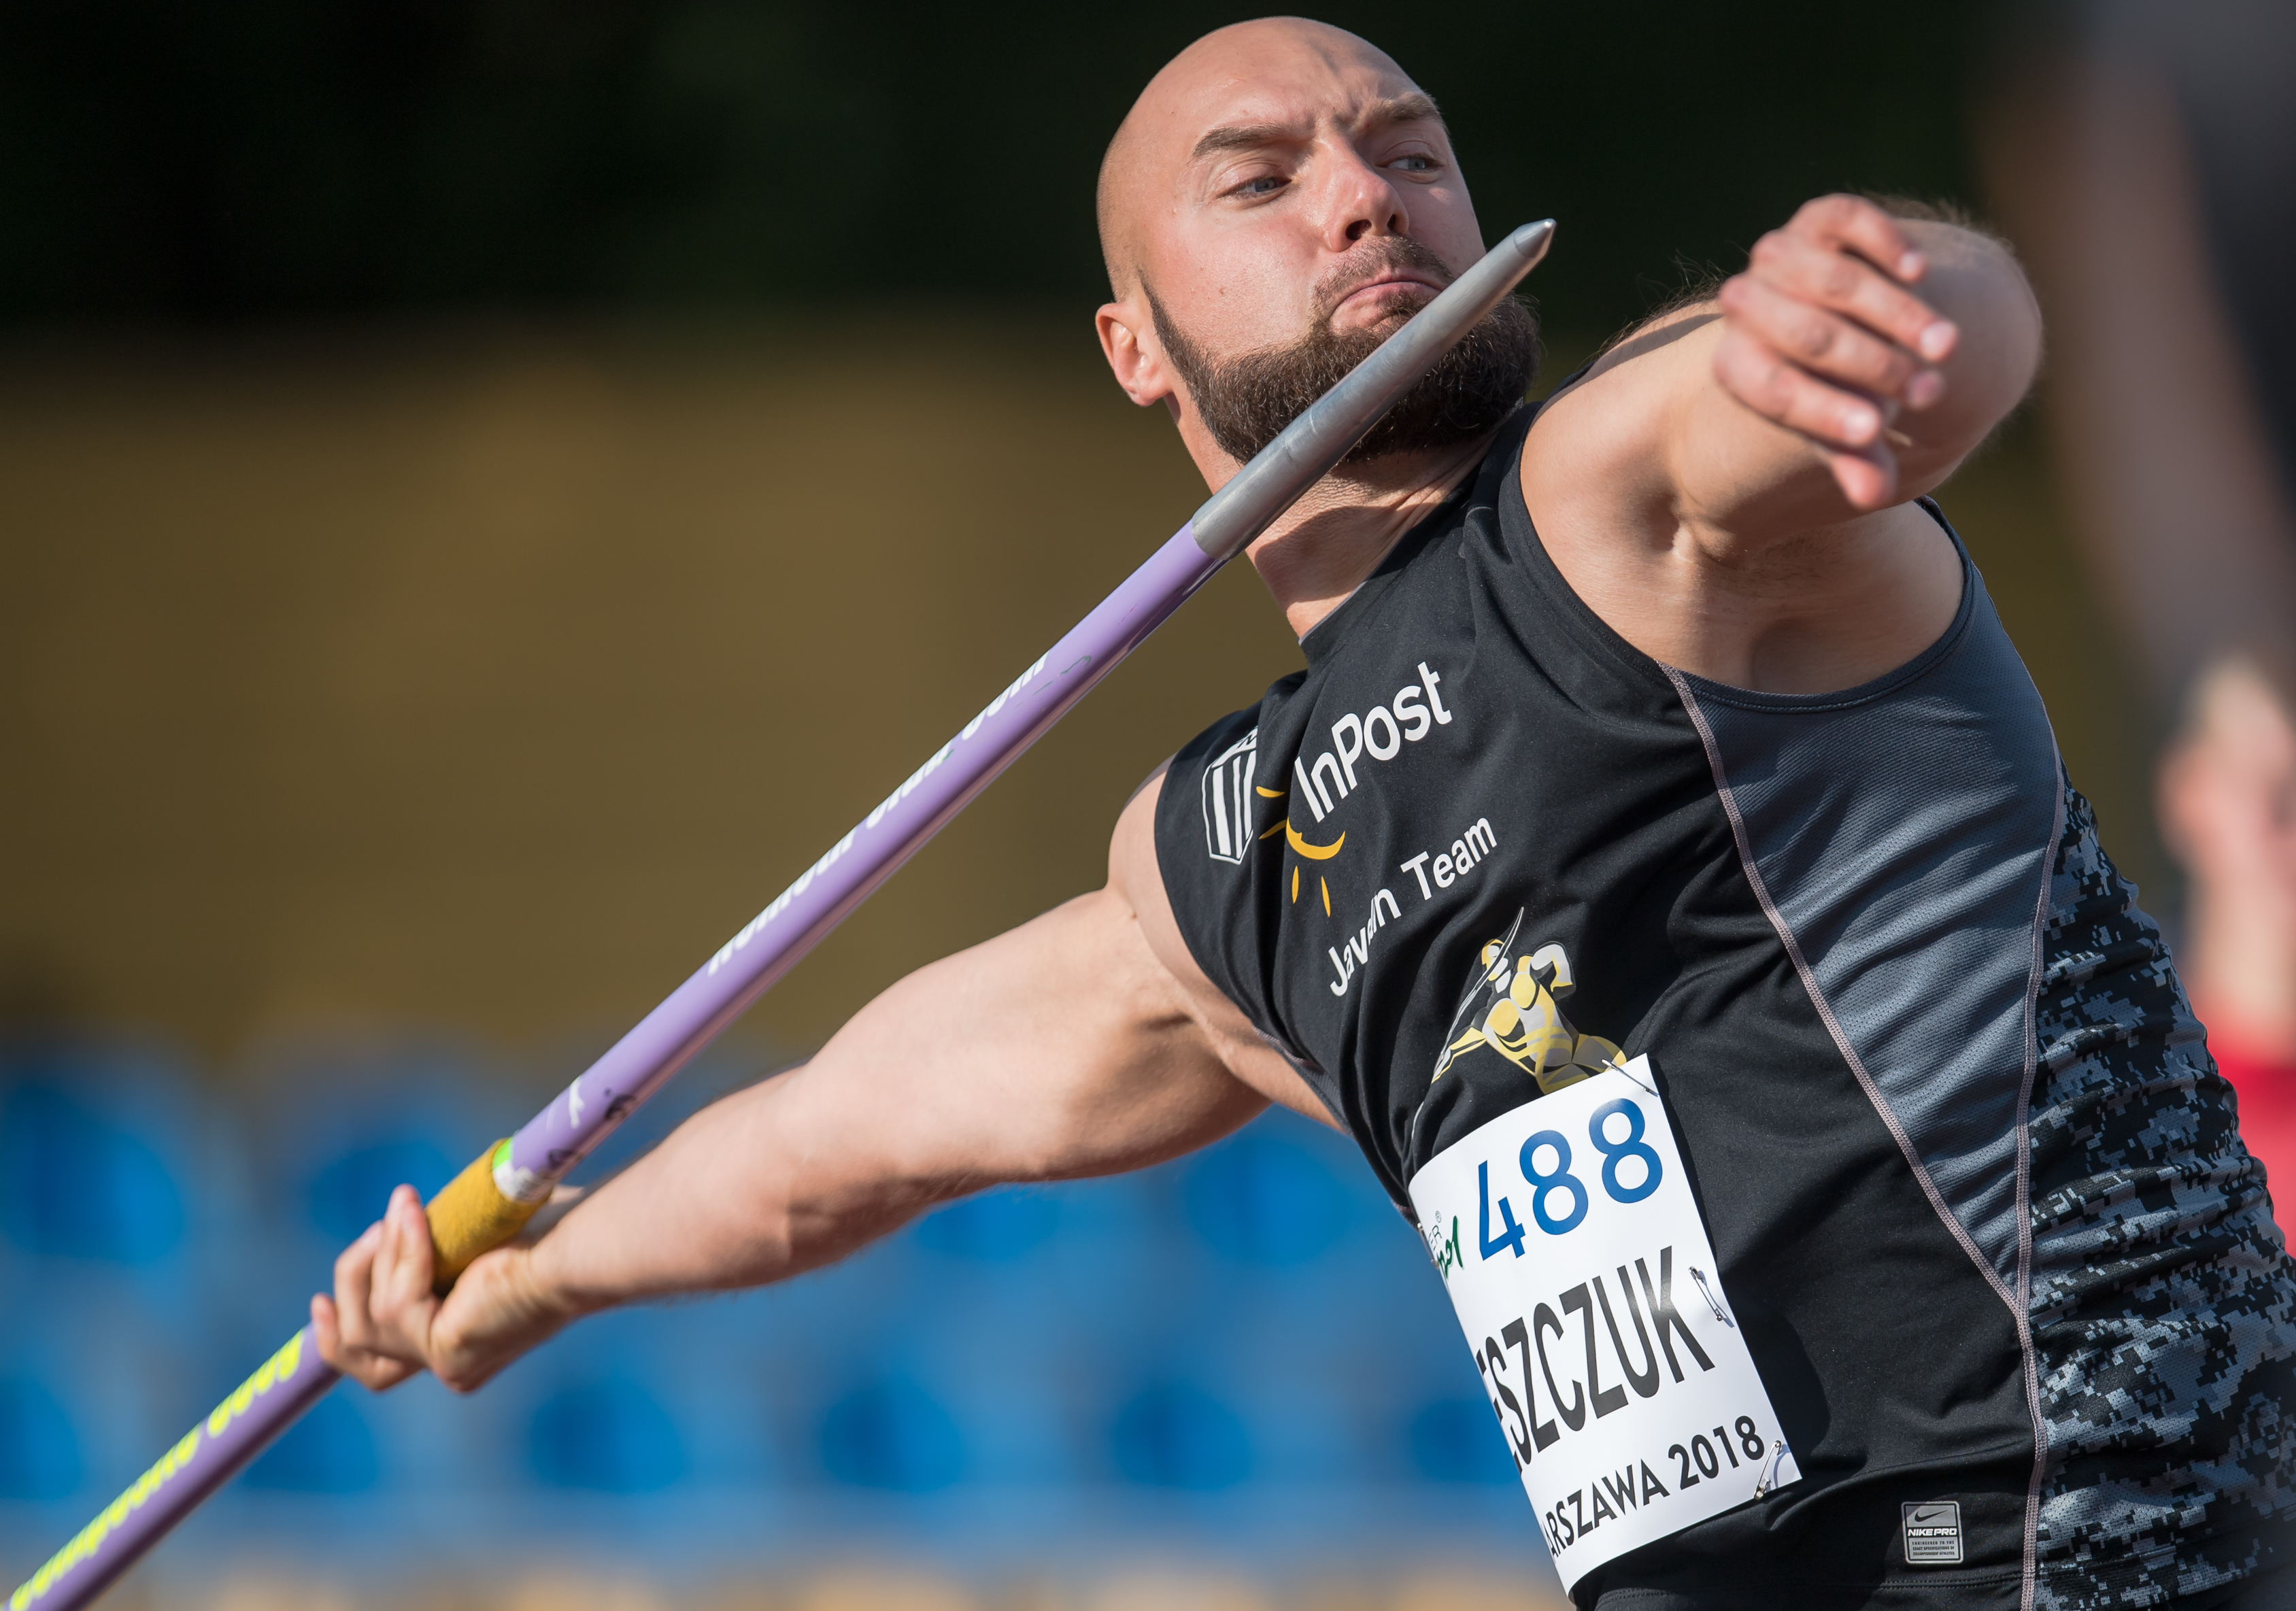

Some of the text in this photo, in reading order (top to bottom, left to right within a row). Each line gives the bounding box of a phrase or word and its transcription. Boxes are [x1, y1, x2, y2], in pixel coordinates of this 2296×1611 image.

[1294, 661, 1453, 823] InPost
[1400, 817, 1498, 900] Team
[1478, 1098, 1663, 1261] 488
[1541, 1415, 1765, 1559] ARSZAWA 2018
[1908, 1527, 1957, 1537] NIKE PRO
